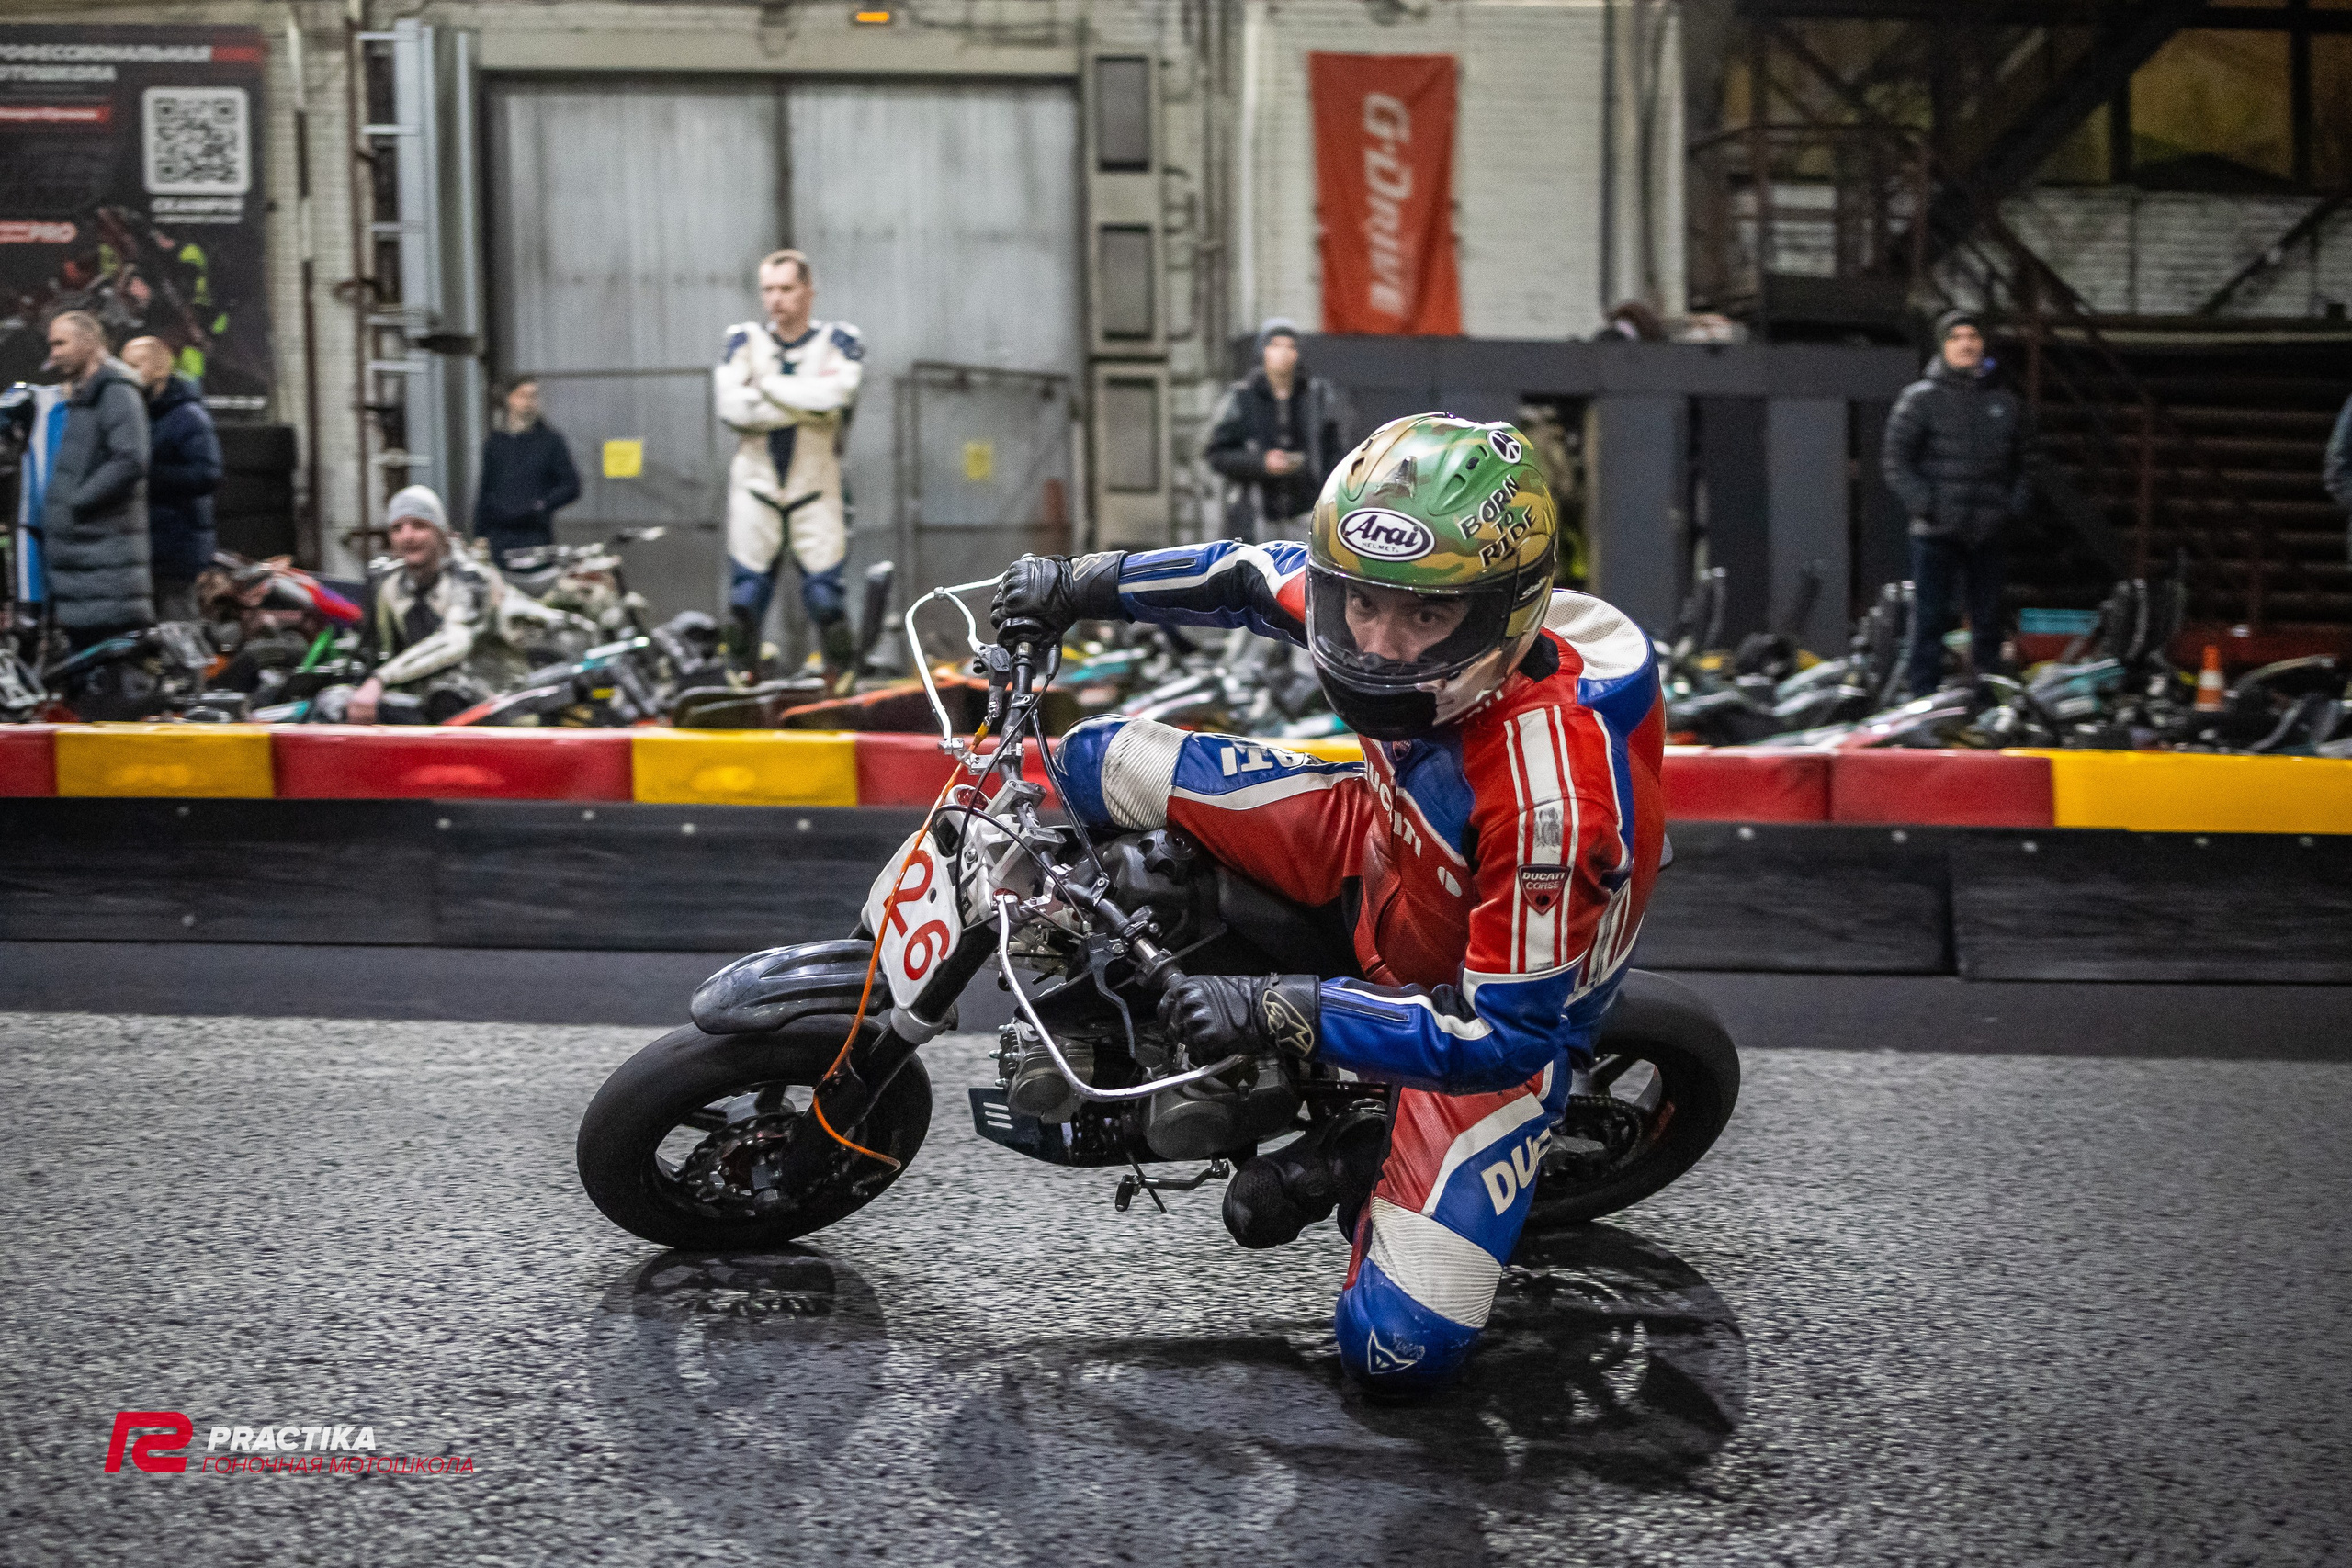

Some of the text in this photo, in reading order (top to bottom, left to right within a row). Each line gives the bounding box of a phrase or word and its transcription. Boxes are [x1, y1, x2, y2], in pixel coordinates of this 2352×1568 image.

[1457, 474, 1520, 540] BORN
[1490, 511, 1514, 535] TO
[1343, 515, 1419, 547] Arai
[1478, 504, 1537, 568] RIDE
[1522, 872, 1565, 881] DUCATI
[1526, 881, 1560, 890] CORSE
[883, 849, 950, 980] 26
